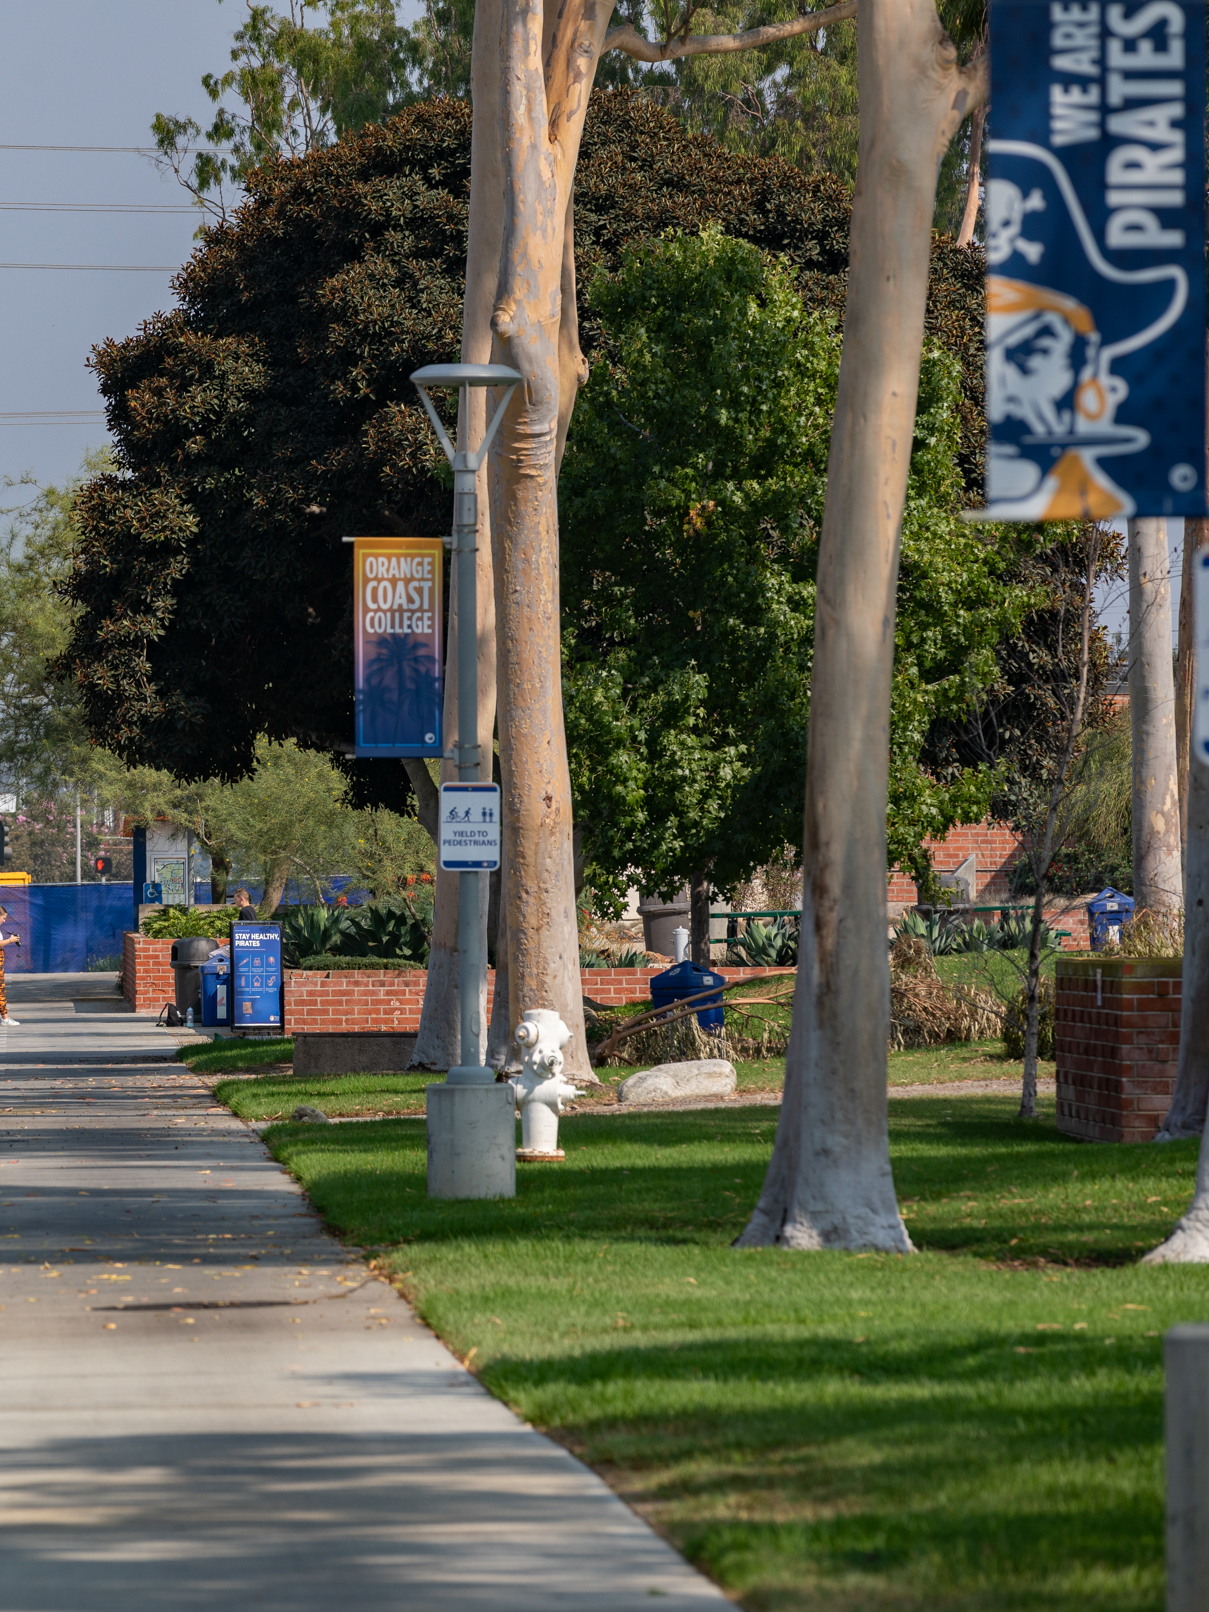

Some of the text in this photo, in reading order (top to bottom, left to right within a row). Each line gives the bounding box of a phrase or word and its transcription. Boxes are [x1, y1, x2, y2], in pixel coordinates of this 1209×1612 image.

[1050, 1, 1101, 147] WE ARE
[1106, 0, 1186, 249] PIRATES
[365, 556, 433, 579] ORANGE
[365, 580, 433, 610] COAST
[365, 611, 433, 634] COLLEGE
[442, 838, 498, 847] PEDESTRIANS
[452, 830, 489, 838] YIELD TO
[251, 933, 280, 941] HEALTHY,
